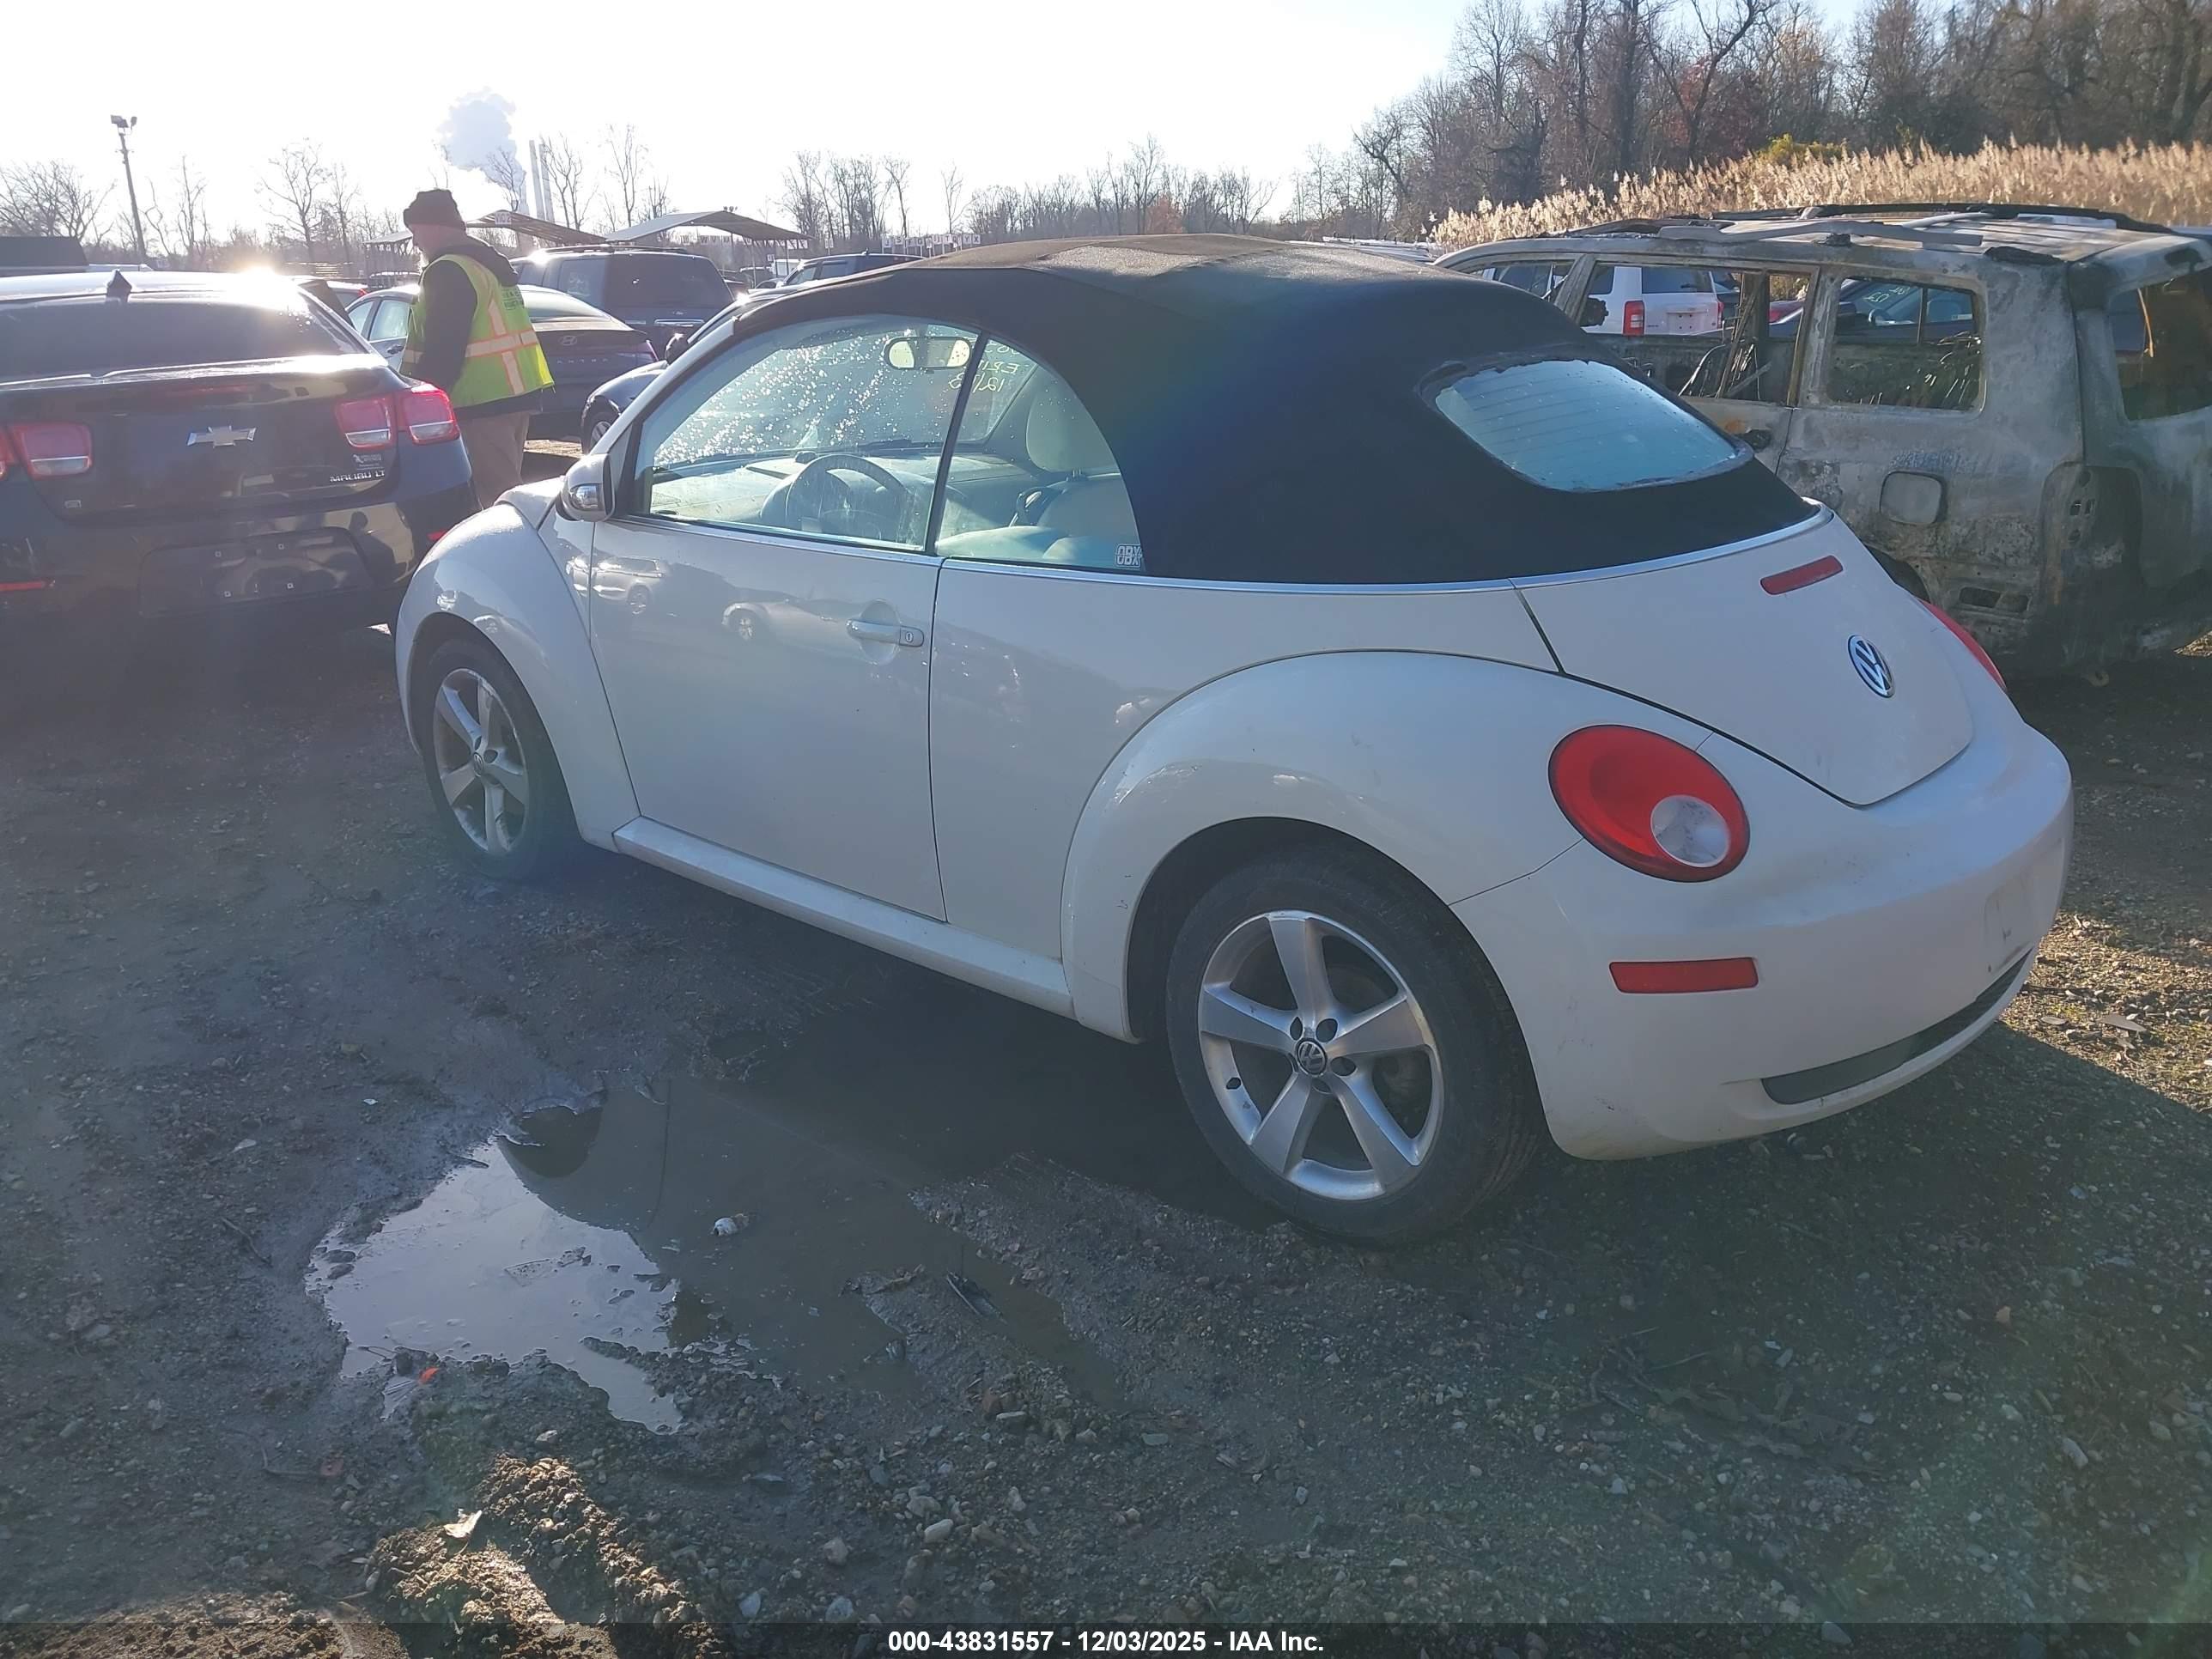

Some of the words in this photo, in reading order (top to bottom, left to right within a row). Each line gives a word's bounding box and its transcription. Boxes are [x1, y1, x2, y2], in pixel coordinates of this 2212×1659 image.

[330, 471, 372, 483] MALIBU
[374, 469, 386, 477] LT
[1116, 545, 1142, 566] OBX
